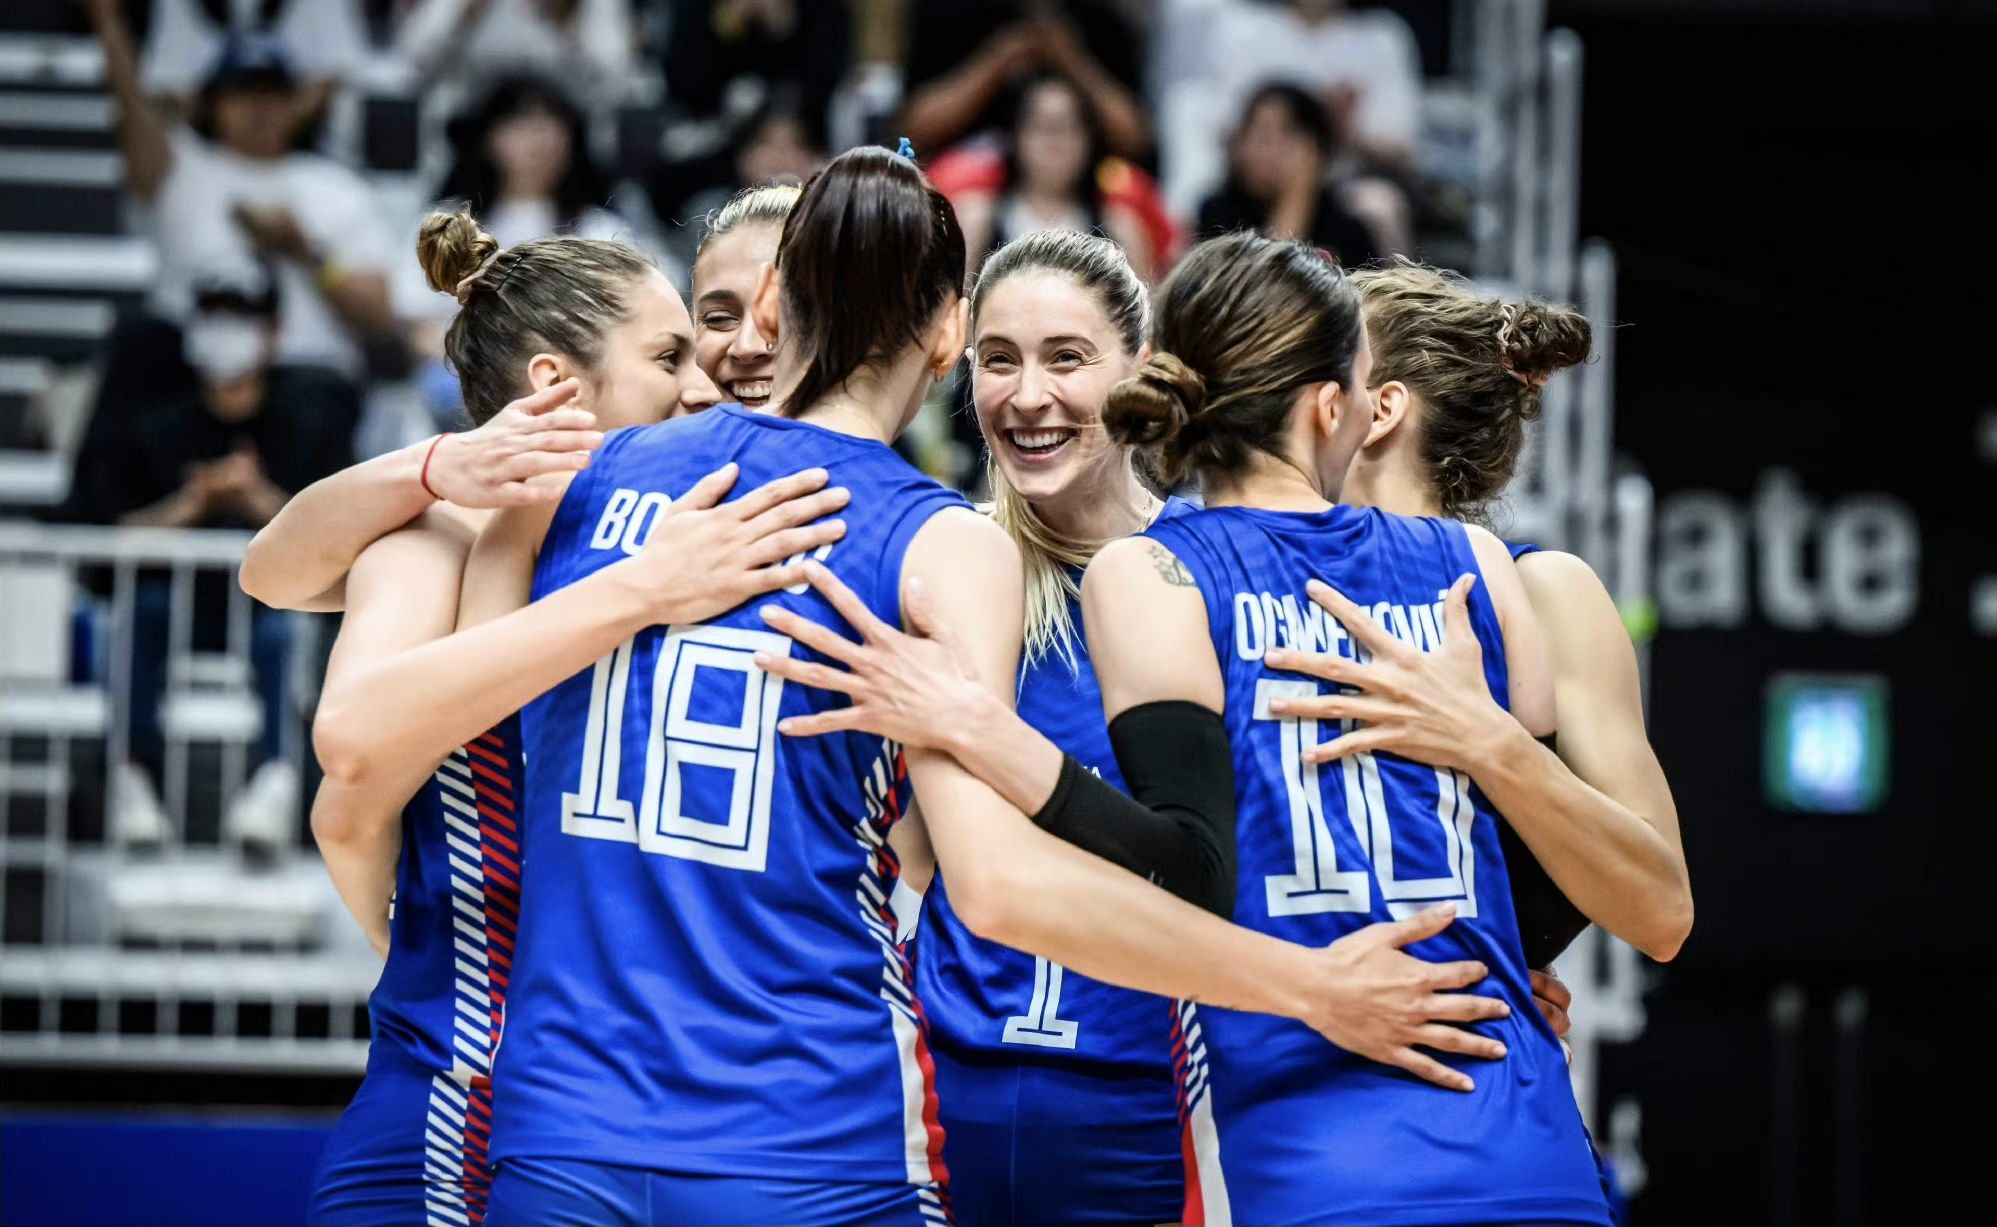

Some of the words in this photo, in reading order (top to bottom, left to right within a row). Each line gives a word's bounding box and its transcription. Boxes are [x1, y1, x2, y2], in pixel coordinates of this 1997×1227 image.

[1655, 466, 1920, 633] ate
[561, 624, 793, 873] 18
[1253, 678, 1478, 922] 10
